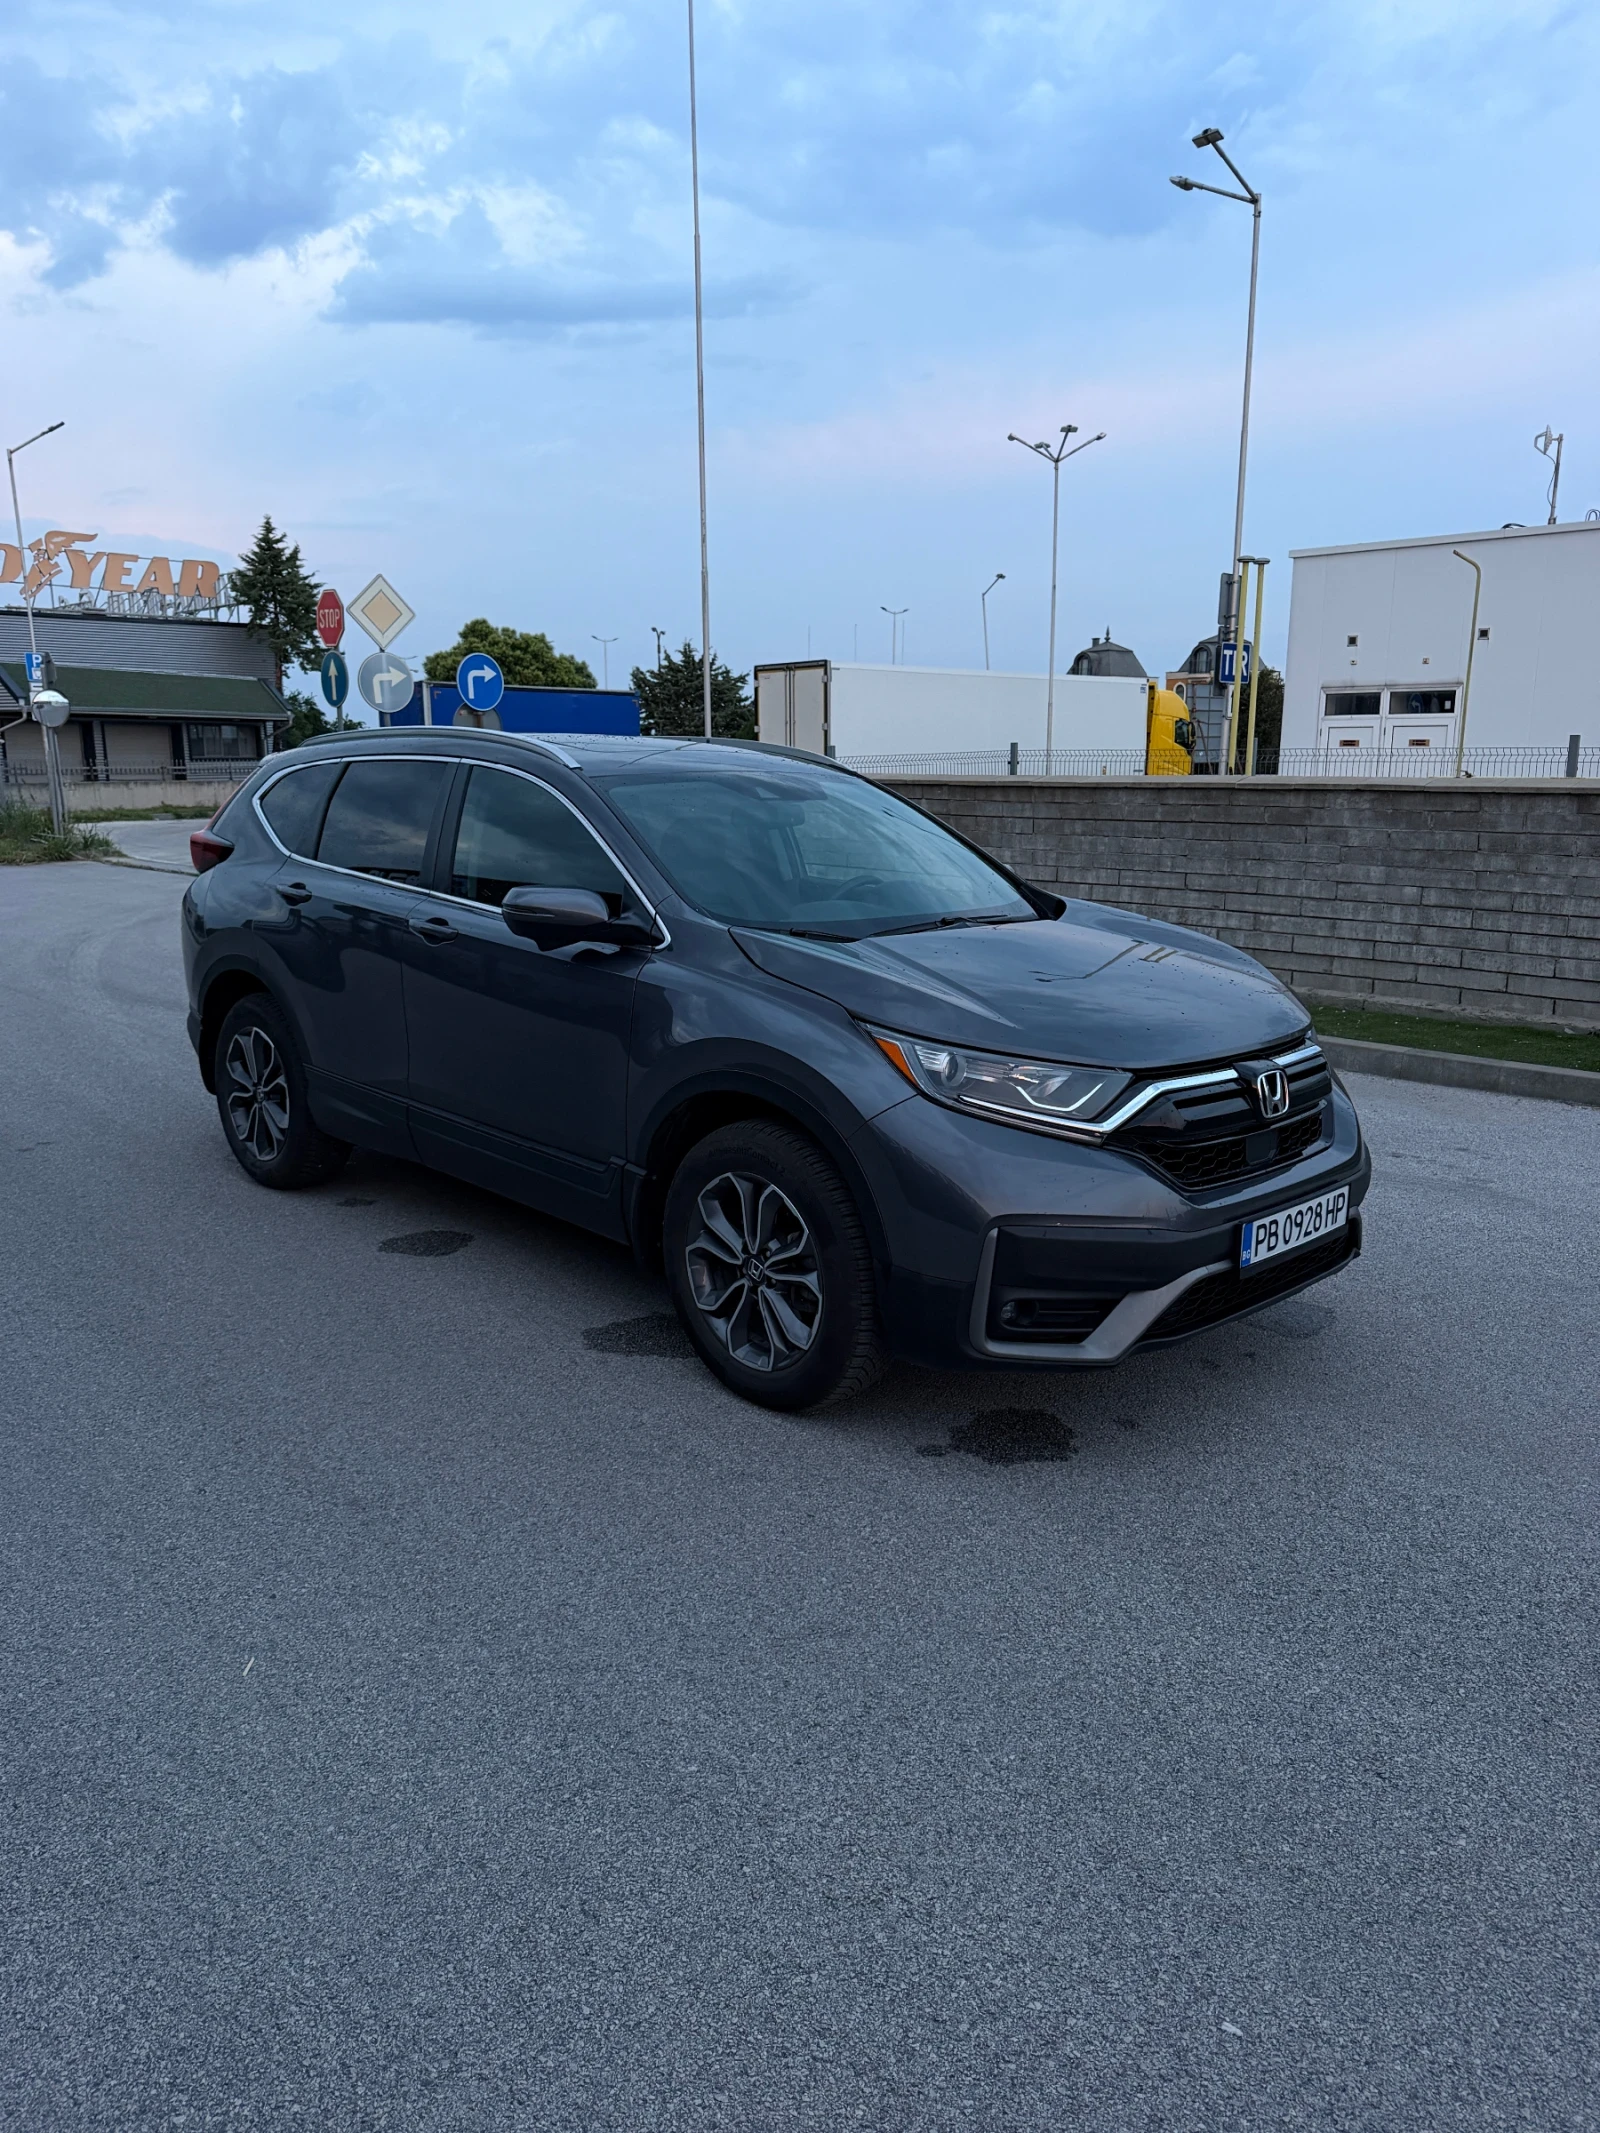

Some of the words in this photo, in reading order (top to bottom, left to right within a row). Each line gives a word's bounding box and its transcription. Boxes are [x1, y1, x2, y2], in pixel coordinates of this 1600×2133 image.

[319, 608, 340, 628] STOP
[32, 654, 42, 667] P
[1254, 1218, 1279, 1258] PB
[1283, 1201, 1323, 1245] 0928
[1324, 1192, 1346, 1229] HP
[1242, 1249, 1251, 1261] BG
